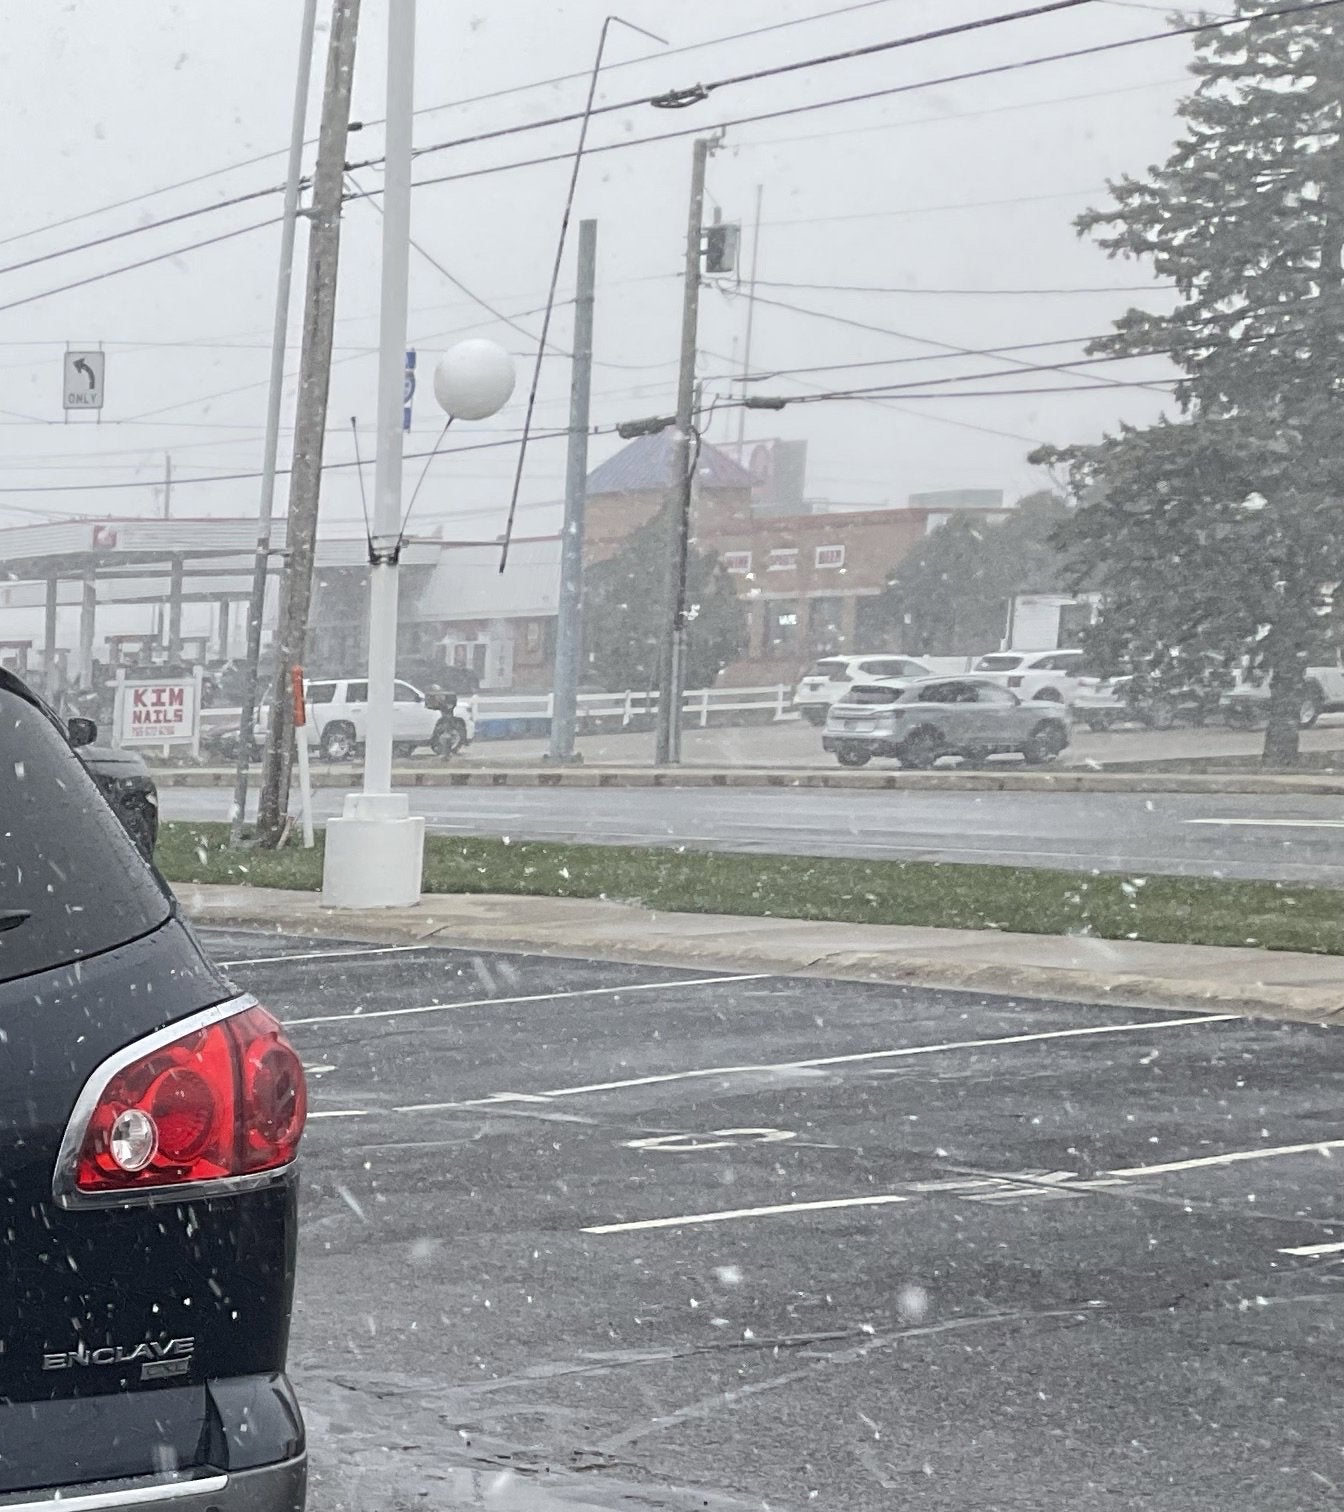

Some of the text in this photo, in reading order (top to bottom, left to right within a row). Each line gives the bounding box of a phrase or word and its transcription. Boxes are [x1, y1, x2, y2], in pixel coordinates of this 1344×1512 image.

[67, 392, 97, 405] ONLY
[132, 687, 185, 708] KIM
[132, 708, 184, 725] NAILS
[42, 1336, 195, 1371] ENCLAVE
